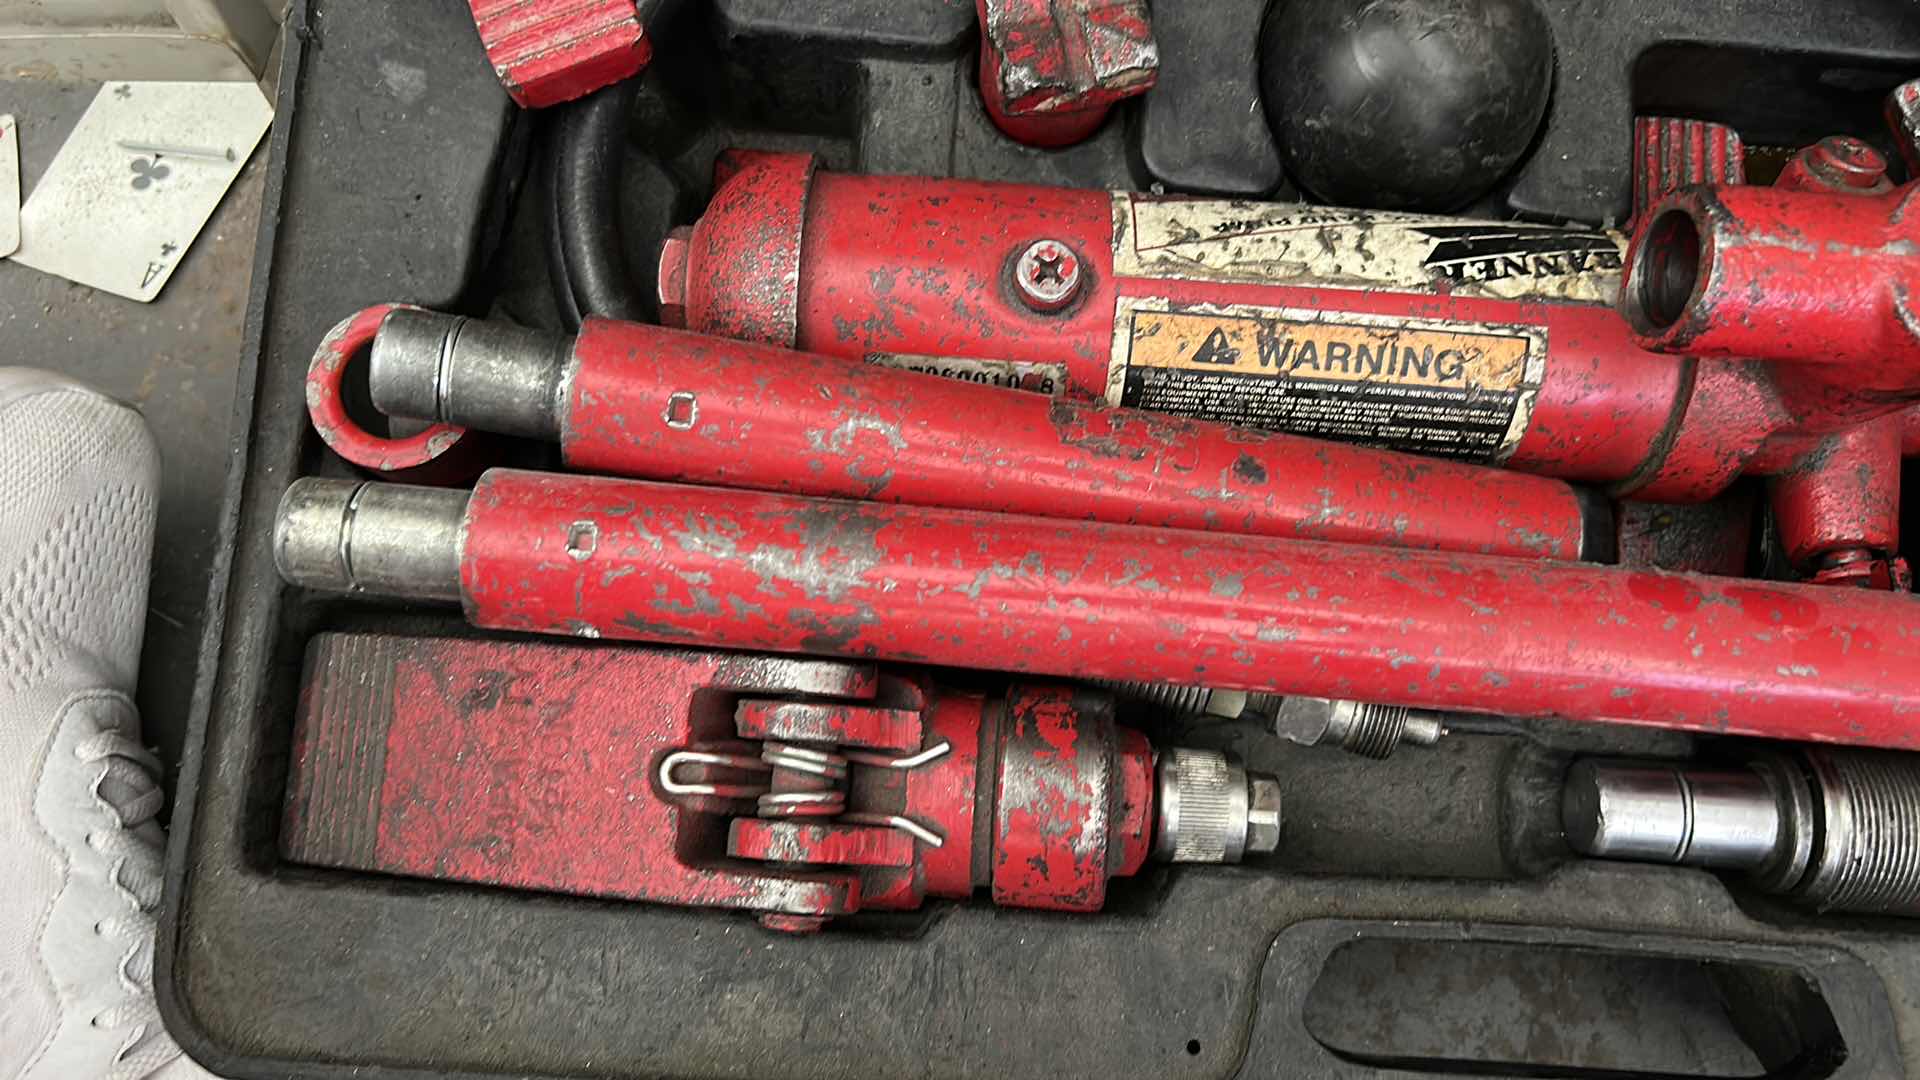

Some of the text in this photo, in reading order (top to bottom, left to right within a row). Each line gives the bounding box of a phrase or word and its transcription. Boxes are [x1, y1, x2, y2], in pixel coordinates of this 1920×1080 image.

[141, 262, 165, 288] A
[1258, 334, 1466, 380] WARNING
[1186, 383, 1233, 392] EQUIPMENT
[1234, 386, 1267, 394] BEFORE
[1219, 392, 1260, 401] DEIGNED
[1278, 381, 1293, 389] ALL
[1362, 387, 1406, 397] PERATING
